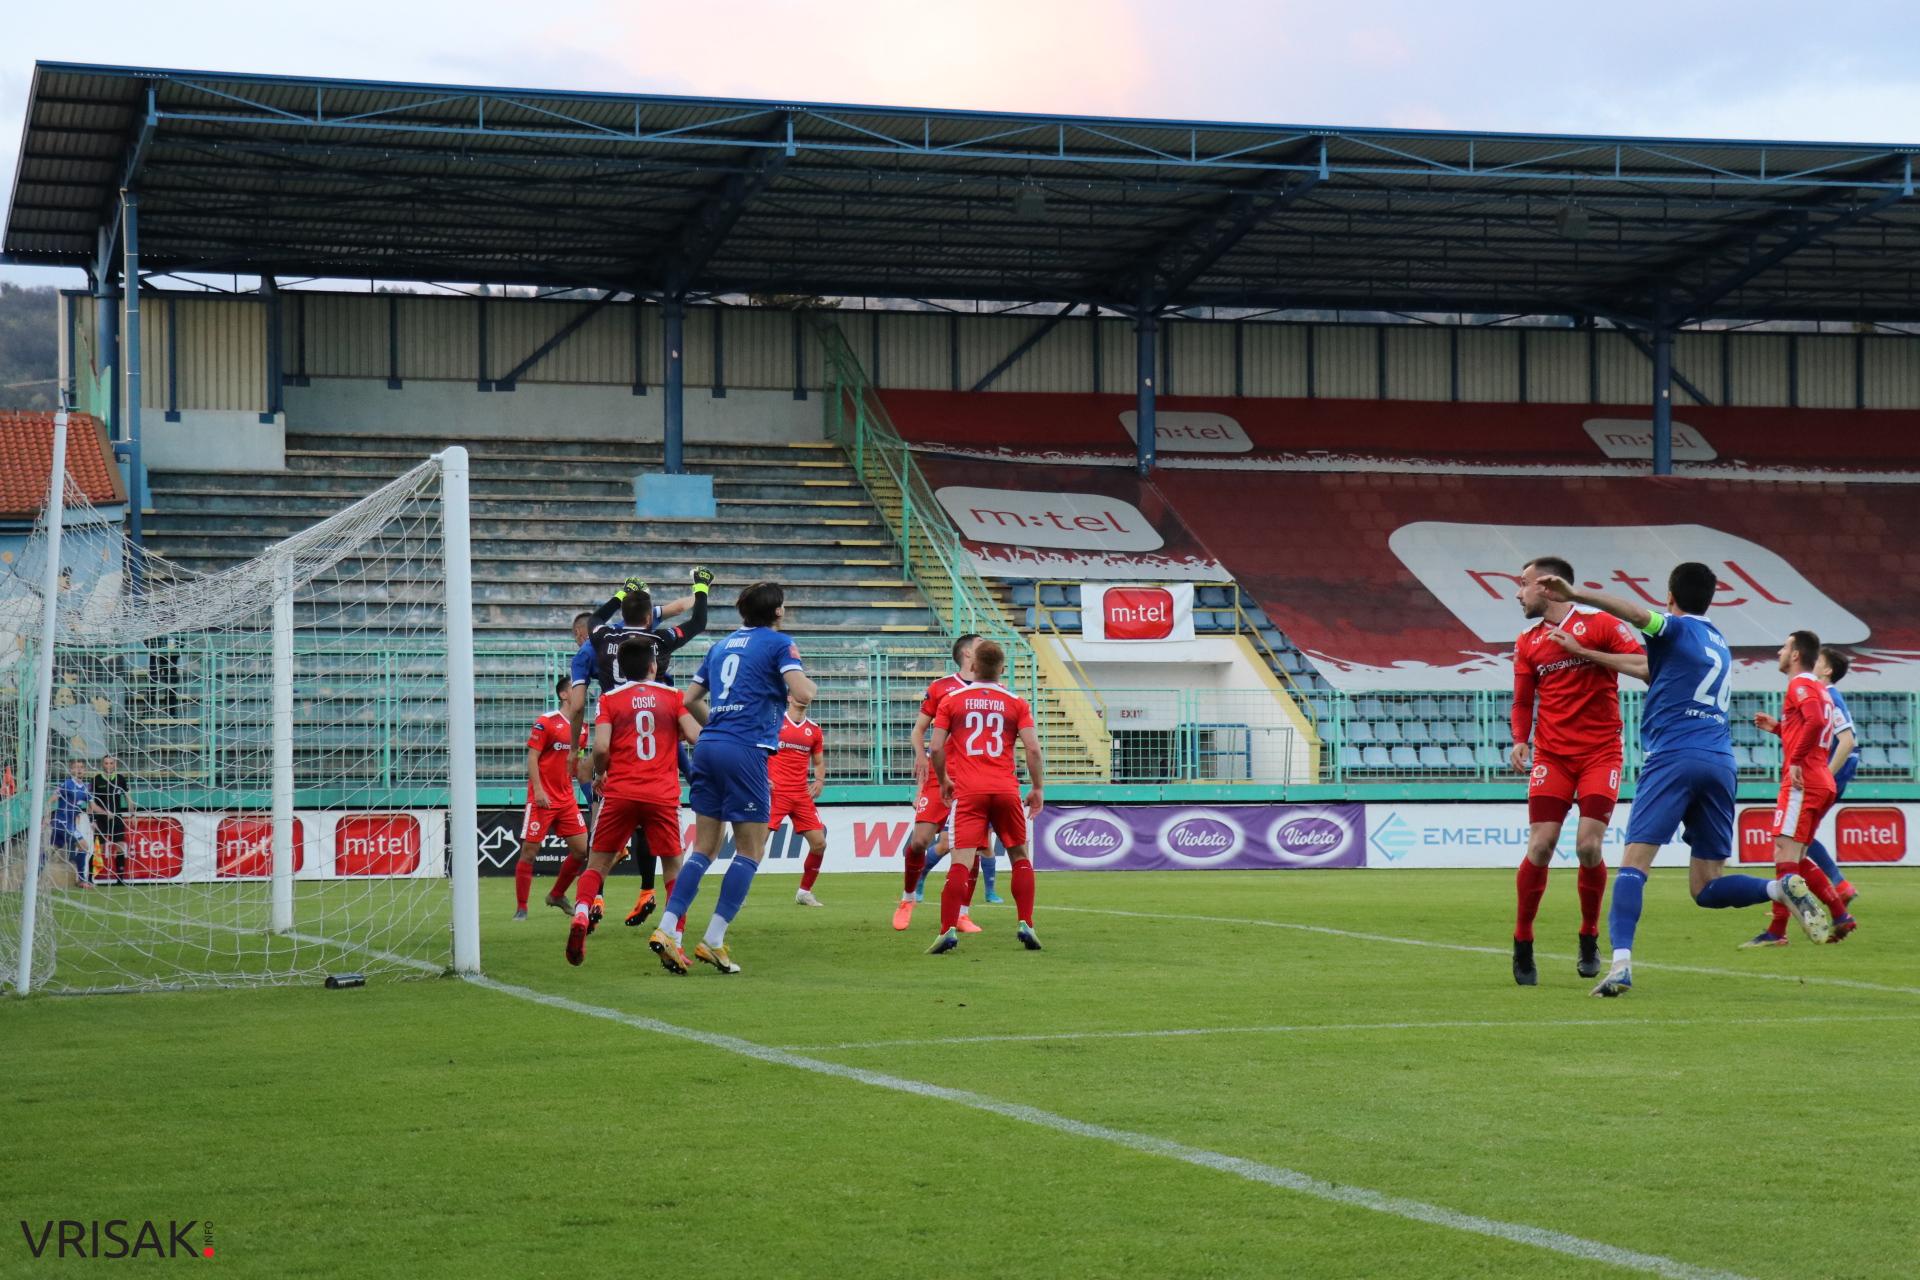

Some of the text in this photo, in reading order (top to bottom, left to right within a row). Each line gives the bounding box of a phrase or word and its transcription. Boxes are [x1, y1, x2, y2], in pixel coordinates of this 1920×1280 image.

[1604, 432, 1697, 448] m:el
[970, 508, 1131, 533] m:tel
[1111, 601, 1166, 622] m:tel
[718, 653, 740, 700] 9
[965, 698, 1005, 712] FERREYRA
[635, 711, 656, 761] 8
[965, 712, 1004, 758] 23
[345, 832, 410, 856] m:tel
[1063, 828, 1116, 847] Violeta
[1175, 828, 1228, 847] Violeta
[1284, 827, 1336, 846] Violeta
[1842, 822, 1899, 845] m:tel
